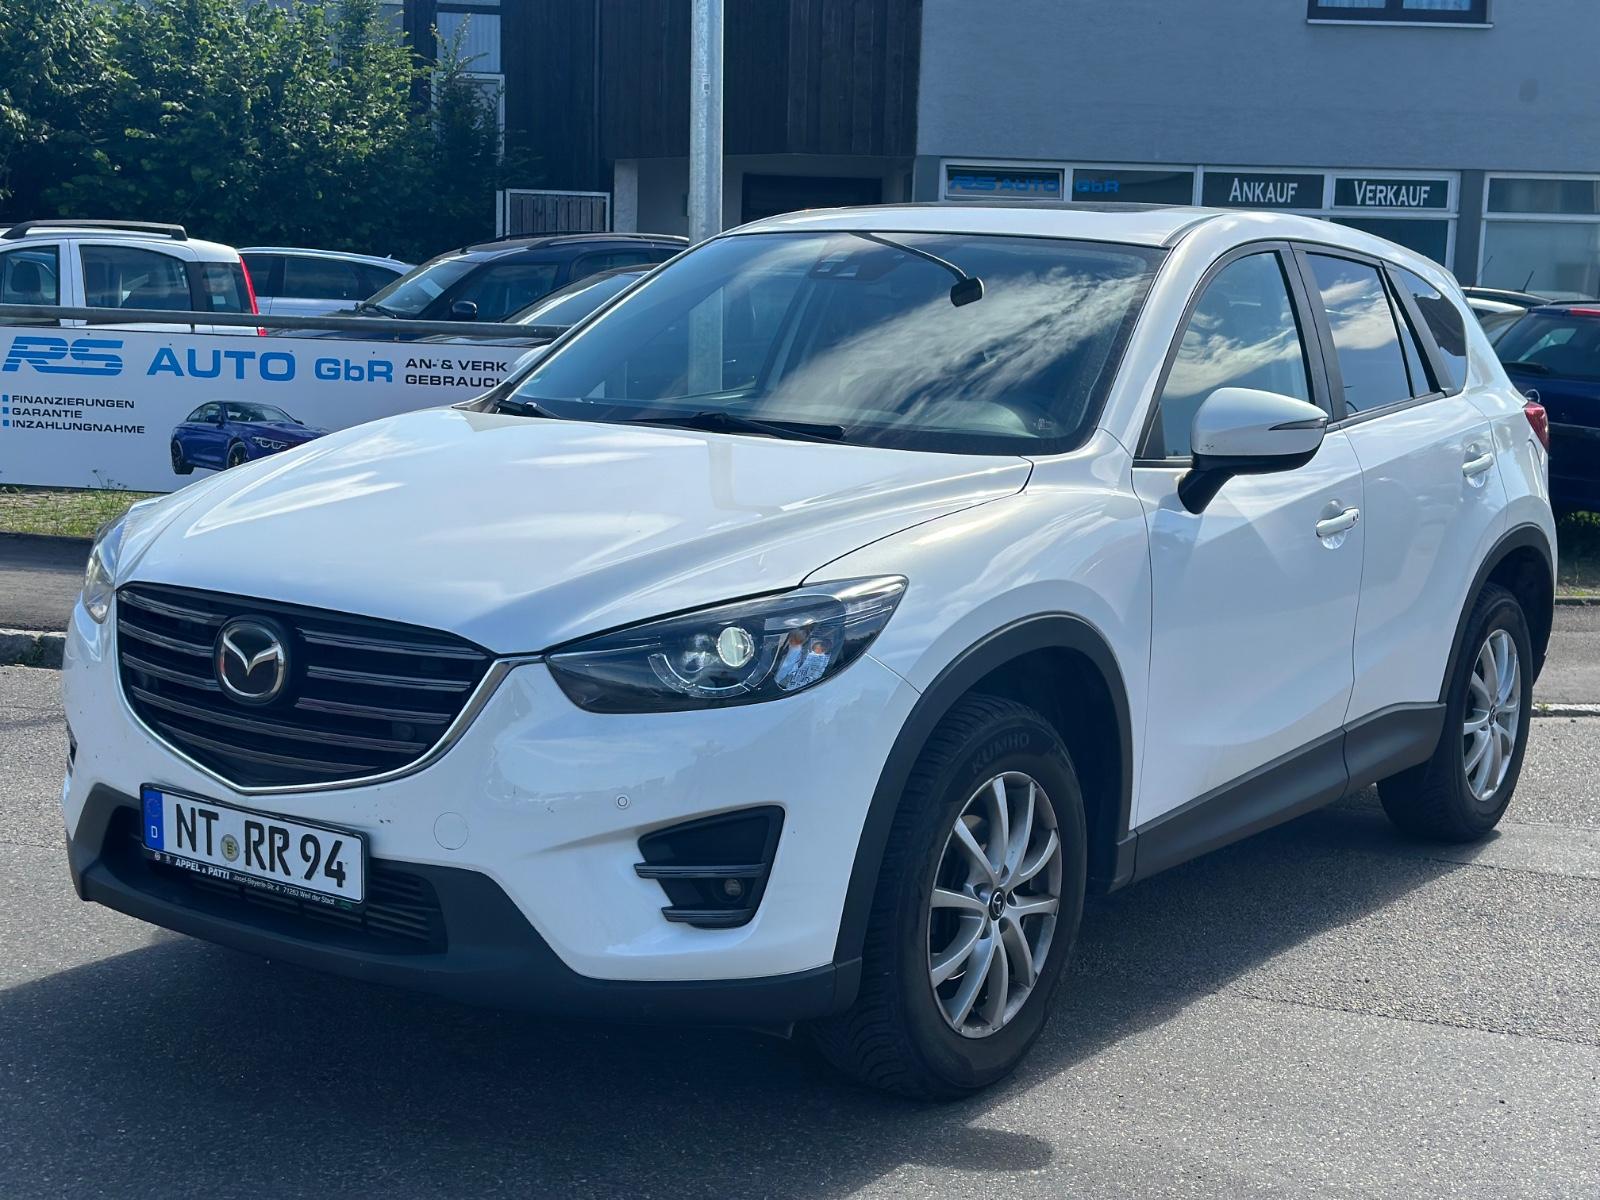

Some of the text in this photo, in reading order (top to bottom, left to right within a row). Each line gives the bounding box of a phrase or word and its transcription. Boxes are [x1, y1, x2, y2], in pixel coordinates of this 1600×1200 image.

[1228, 177, 1298, 203] ANKAUF
[1354, 181, 1431, 206] VERKAUF
[2, 336, 394, 383] RS AUTO GbR
[440, 359, 453, 370] &
[11, 394, 135, 409] FINANZIERUNGEN
[11, 407, 83, 419] GARANTIE
[11, 419, 145, 434] INZAHLUNGNAHME
[176, 803, 346, 888] NT RR 94
[175, 858, 201, 872] APPEL
[207, 866, 230, 879] PATTI
